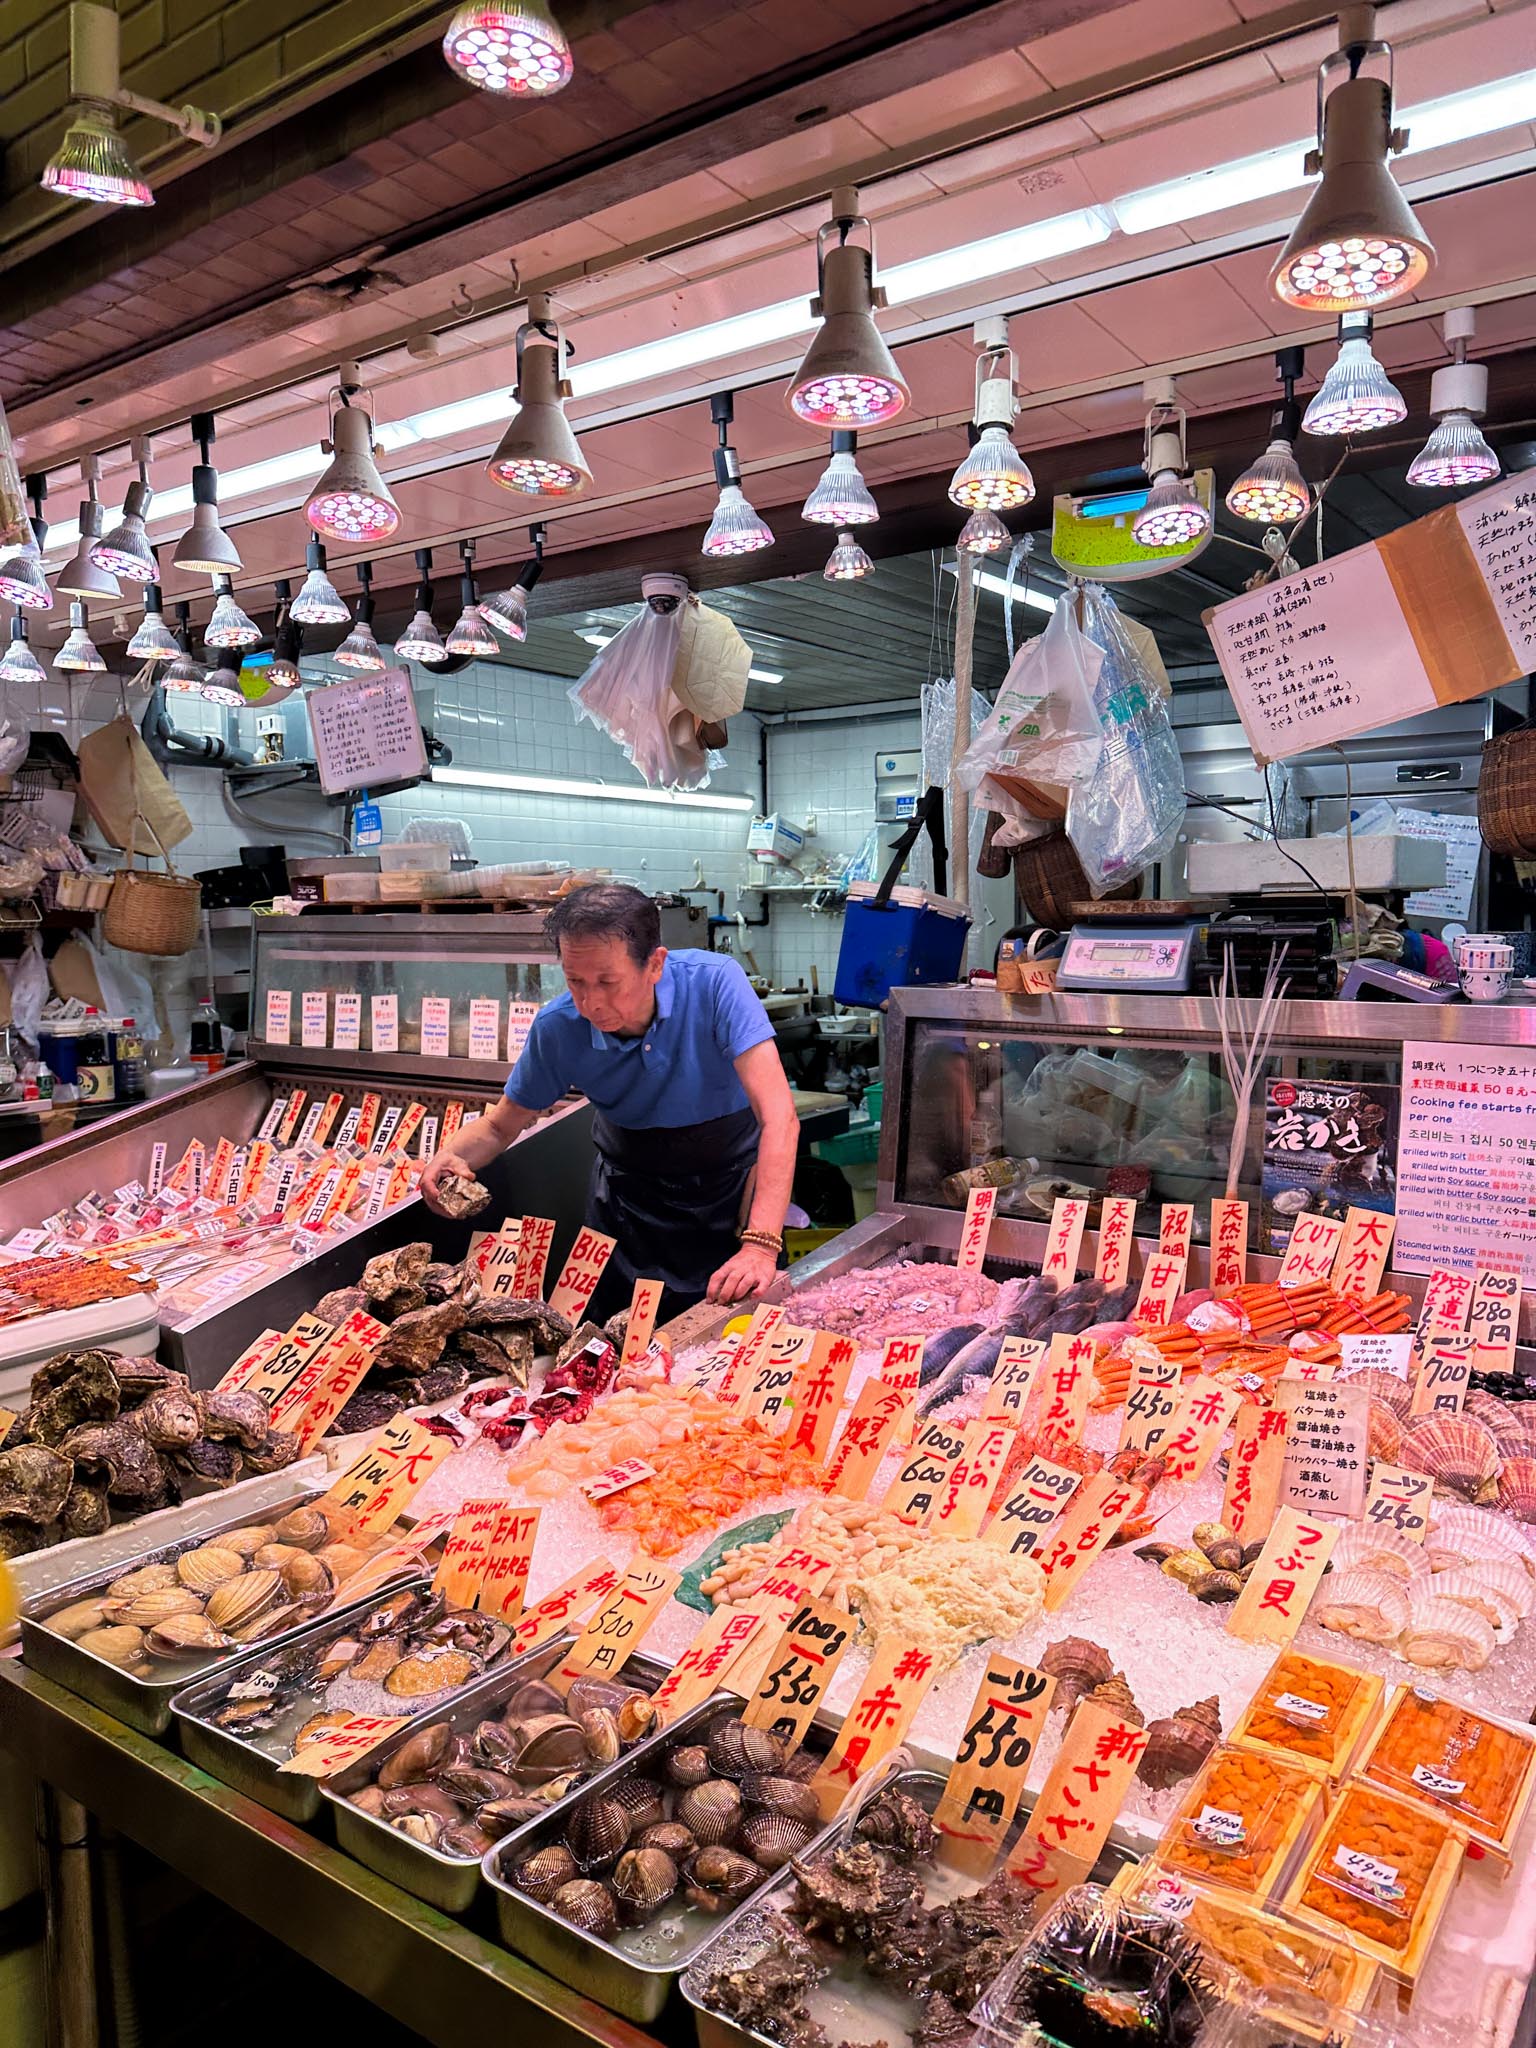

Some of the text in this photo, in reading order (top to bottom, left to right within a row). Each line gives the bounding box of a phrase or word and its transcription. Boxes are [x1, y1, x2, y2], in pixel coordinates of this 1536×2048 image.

[1411, 1060, 1446, 1073] 調理代
[1298, 1090, 1351, 1110] 隠岐の
[1410, 1095, 1522, 1113] Cooking fee starts
[1409, 1113, 1453, 1123] per one
[1408, 1129, 1454, 1143] 조리비는
[1470, 1133, 1492, 1147] 접시
[1499, 1137, 1513, 1148] 50
[1402, 1148, 1429, 1157] grilled
[1430, 1150, 1448, 1158] with
[1449, 1151, 1467, 1161] salt
[1400, 1172, 1427, 1182] grilled
[1427, 1174, 1446, 1184] with
[1447, 1176, 1463, 1187] Soy
[1464, 1179, 1490, 1188] sauce
[1411, 1162, 1487, 1176] grilled with butter
[307, 1178, 335, 1222] 九百円
[1399, 1184, 1426, 1193] grilled
[1427, 1186, 1445, 1195] with
[1446, 1189, 1474, 1199] butter
[1500, 1195, 1527, 1205] sauce
[965, 1190, 993, 1266] 明石たこ
[1398, 1208, 1425, 1218] grilled
[1426, 1210, 1444, 1219] with
[1445, 1212, 1470, 1223] garlic
[1471, 1215, 1499, 1226] butter
[1046, 1201, 1084, 1270] おつくり用
[1102, 1200, 1129, 1284] 天然あじ
[1214, 1201, 1244, 1286] 天然本鯛
[1293, 1220, 1338, 1248] CUT
[571, 1231, 610, 1269] BIG
[1341, 1216, 1389, 1292] 大かに
[1395, 1251, 1431, 1262] Steamed
[1432, 1255, 1450, 1265] with
[1452, 1257, 1473, 1268] WINE
[1396, 1239, 1432, 1250] Steamed
[1433, 1243, 1451, 1253] with
[1453, 1246, 1476, 1256] SAKE
[493, 1274, 513, 1293] 円
[558, 1266, 599, 1296] SIZE
[1133, 1262, 1179, 1325] 甘鯛
[1480, 1271, 1518, 1296] 100g
[1471, 1301, 1512, 1322] 280
[296, 1323, 327, 1341] 一ツ
[1430, 1337, 1478, 1352] 一ツ
[1488, 1324, 1511, 1343] 円
[262, 1343, 302, 1376] 850
[771, 1338, 804, 1357] 一ツ
[882, 1340, 921, 1368] EAT
[1003, 1342, 1039, 1357] 一ツ
[753, 1368, 793, 1393] 200
[991, 1364, 1030, 1386] 150
[1138, 1364, 1178, 1383] 一ツ
[1423, 1356, 1467, 1389] 700
[789, 1339, 854, 1457] 新赤貝
[1003, 1391, 1021, 1409] 円
[1043, 1337, 1092, 1441] 新甘えび
[1304, 1389, 1338, 1402] 塩焼き
[762, 1396, 782, 1416] 円
[1126, 1386, 1173, 1421] 450
[1294, 1405, 1347, 1420] バター焼き
[1433, 1394, 1459, 1413] 円
[858, 1392, 905, 1457] 今すぐ
[1162, 1391, 1226, 1480] 赤えび
[1296, 1420, 1342, 1436] 醤油焼き
[384, 1428, 412, 1451] 一ツ
[918, 1424, 965, 1459] 100g
[900, 1456, 946, 1483] 600
[1021, 1463, 1076, 1496] 100g
[1230, 1410, 1287, 1533] 新はまぐり
[1298, 1469, 1332, 1484] 酒蒸し
[1288, 1485, 1340, 1502] ワイン蒸し
[1380, 1474, 1428, 1497] 一ツ
[906, 1493, 934, 1515] 円
[1000, 1493, 1056, 1524] 400
[1367, 1499, 1424, 1531] 450
[491, 1515, 536, 1547] EAT
[1009, 1531, 1038, 1555] 円
[444, 1536, 485, 1557] GRILL
[483, 1554, 531, 1583] HERE
[774, 1548, 832, 1576] EAT
[1258, 1524, 1324, 1618] つぶ貝
[627, 1571, 666, 1592] 一ツ
[751, 1576, 812, 1605] HERE
[588, 1597, 634, 1638] 500
[786, 1607, 848, 1657] 100g
[586, 1644, 616, 1670] 円
[759, 1656, 821, 1706] 550
[987, 1669, 1047, 1704] 一ツ
[343, 1717, 401, 1732] EAT
[828, 1647, 934, 1786] 新赤貝
[319, 1733, 381, 1748] HERE
[956, 1706, 1032, 1769] 550
[961, 1786, 1006, 1825] 円
[1009, 1722, 1147, 1889] 新さざえ
